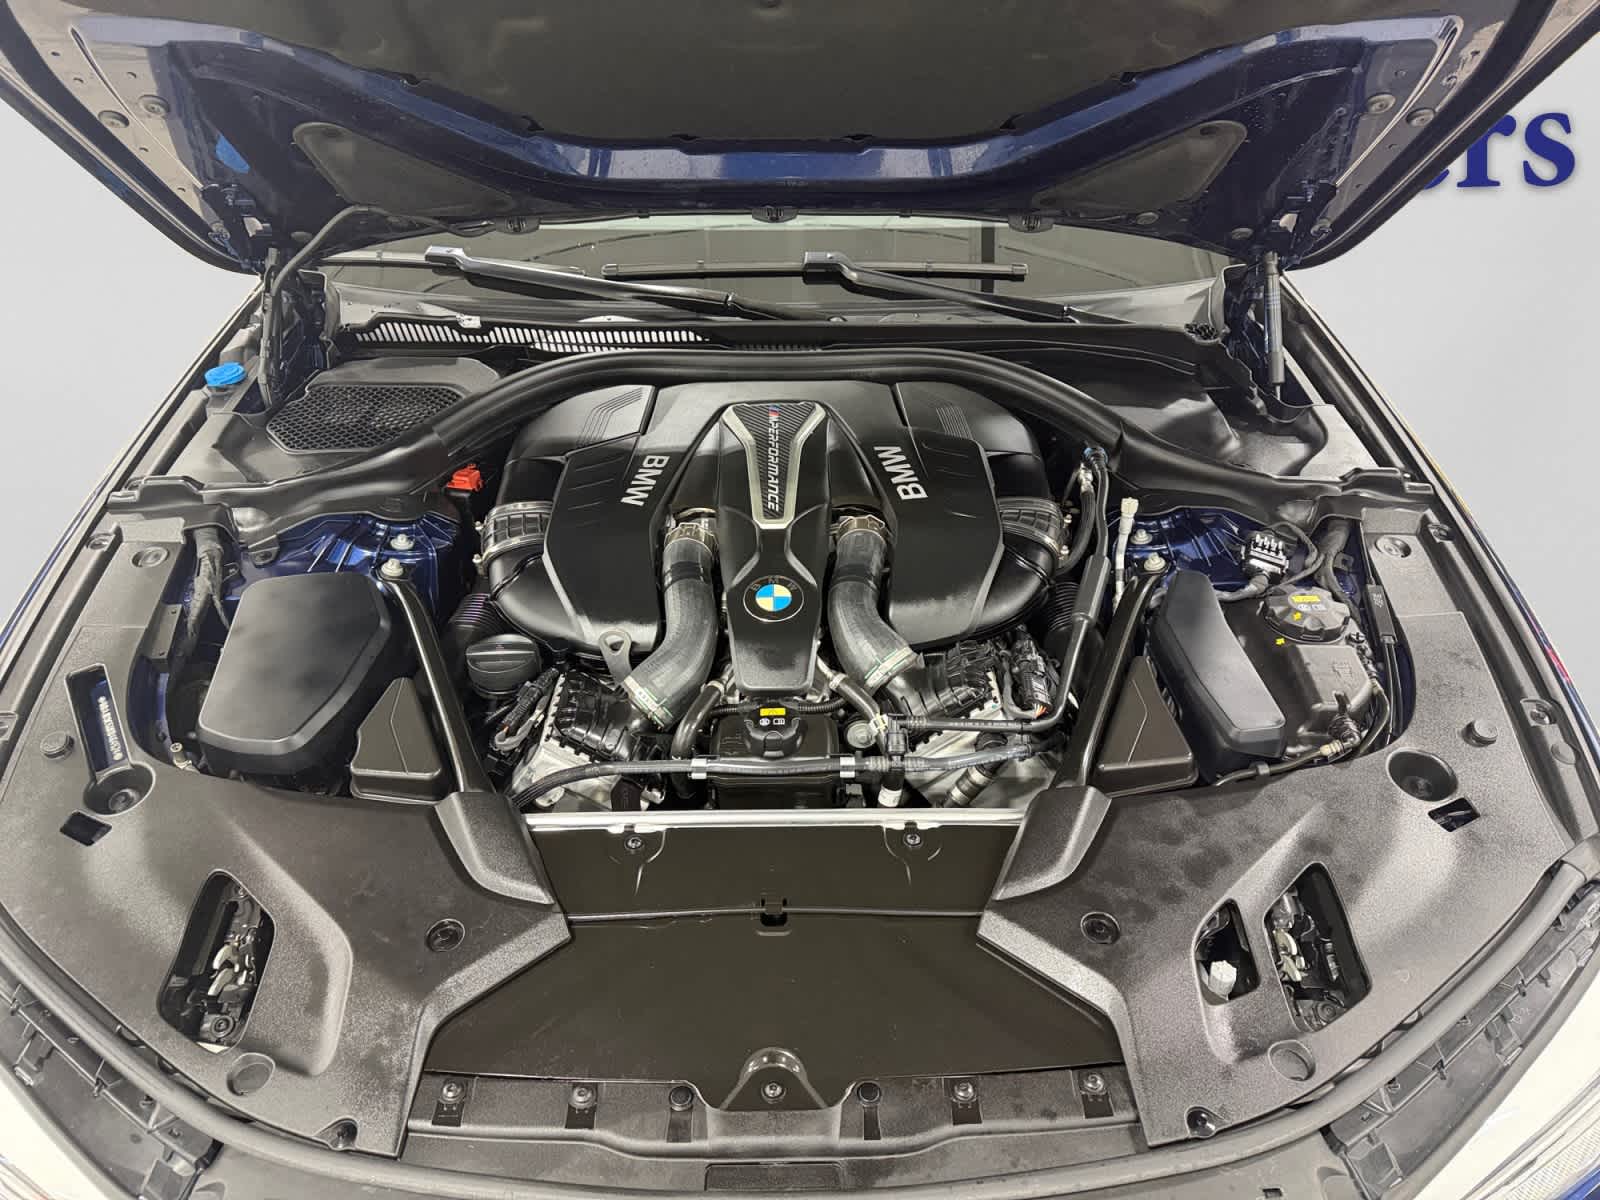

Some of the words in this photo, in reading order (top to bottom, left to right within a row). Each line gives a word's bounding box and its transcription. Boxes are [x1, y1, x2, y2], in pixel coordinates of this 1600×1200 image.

[1424, 112, 1576, 190] rs
[620, 455, 670, 506] BMW
[873, 446, 928, 500] BMW
